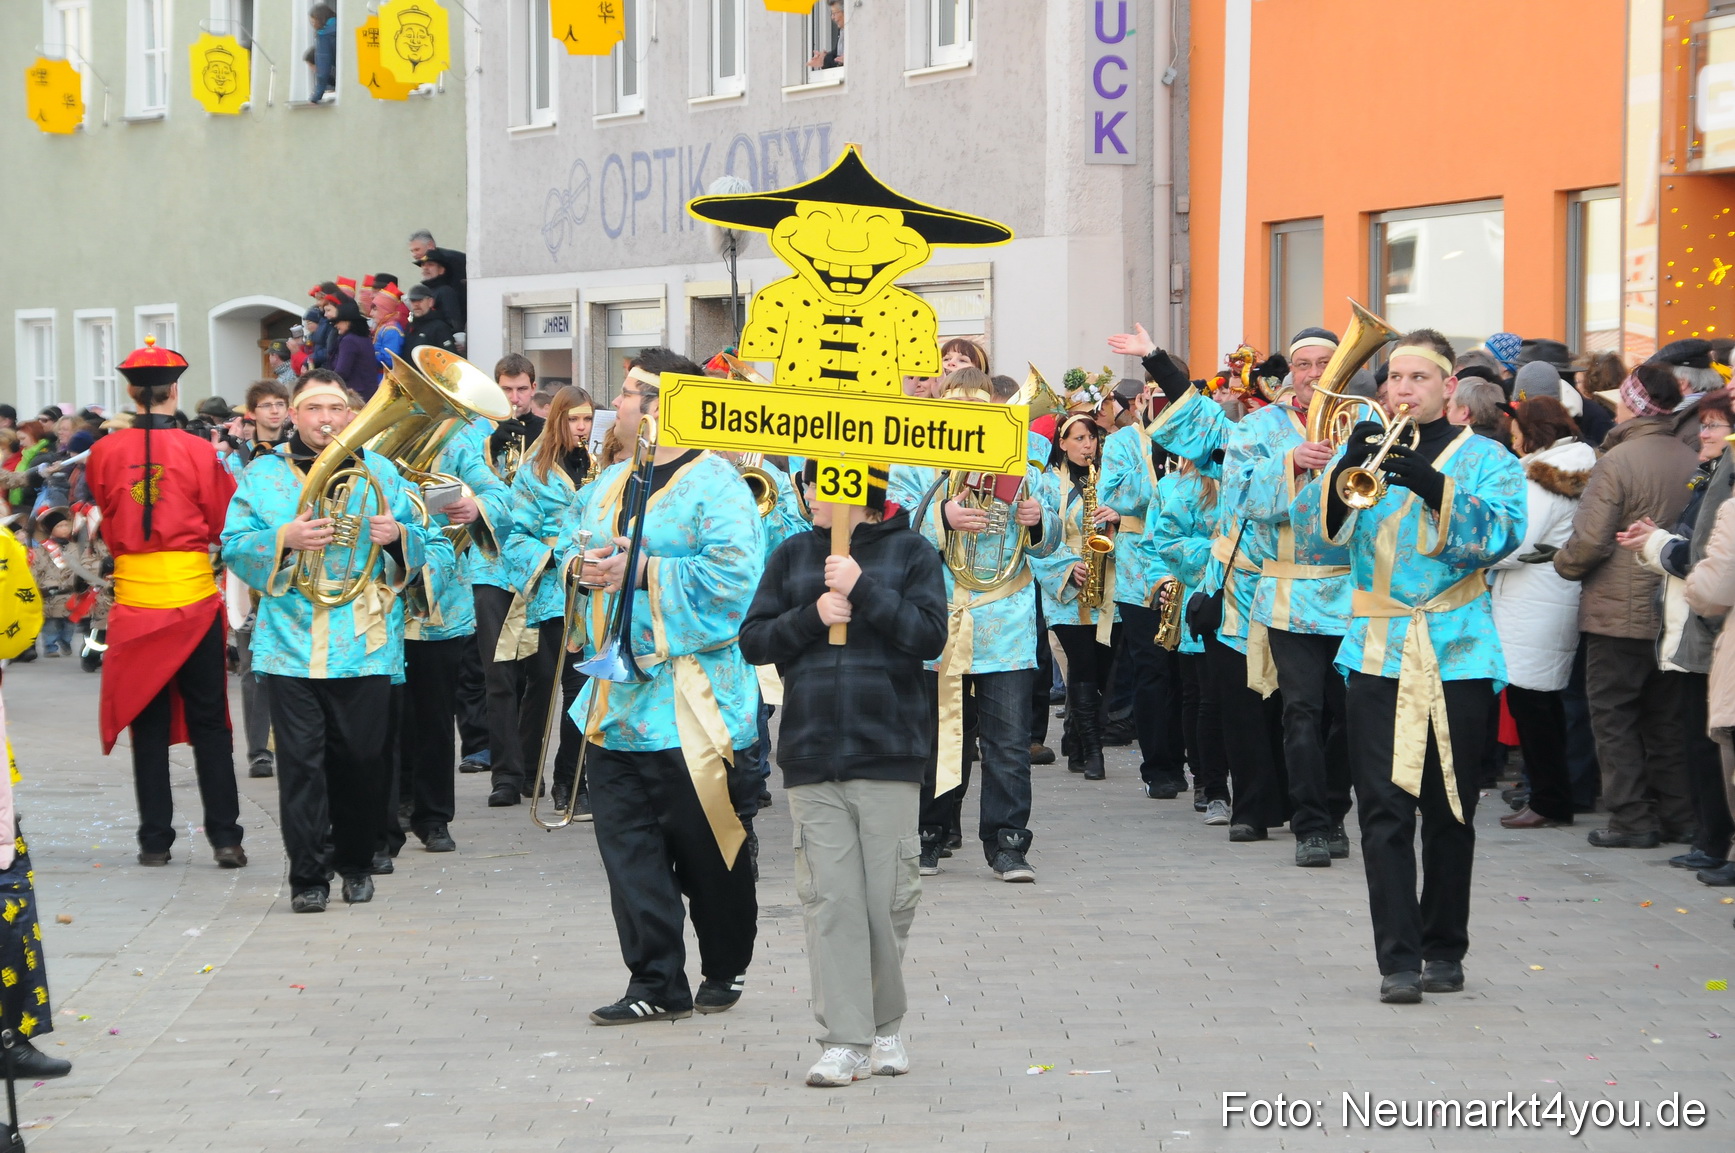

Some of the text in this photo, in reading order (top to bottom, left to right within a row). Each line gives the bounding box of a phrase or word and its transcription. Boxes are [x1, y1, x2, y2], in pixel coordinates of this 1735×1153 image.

[600, 142, 712, 239] OPTIK
[700, 400, 986, 454] Blaskapellen Dietfurt
[820, 466, 863, 499] 33
